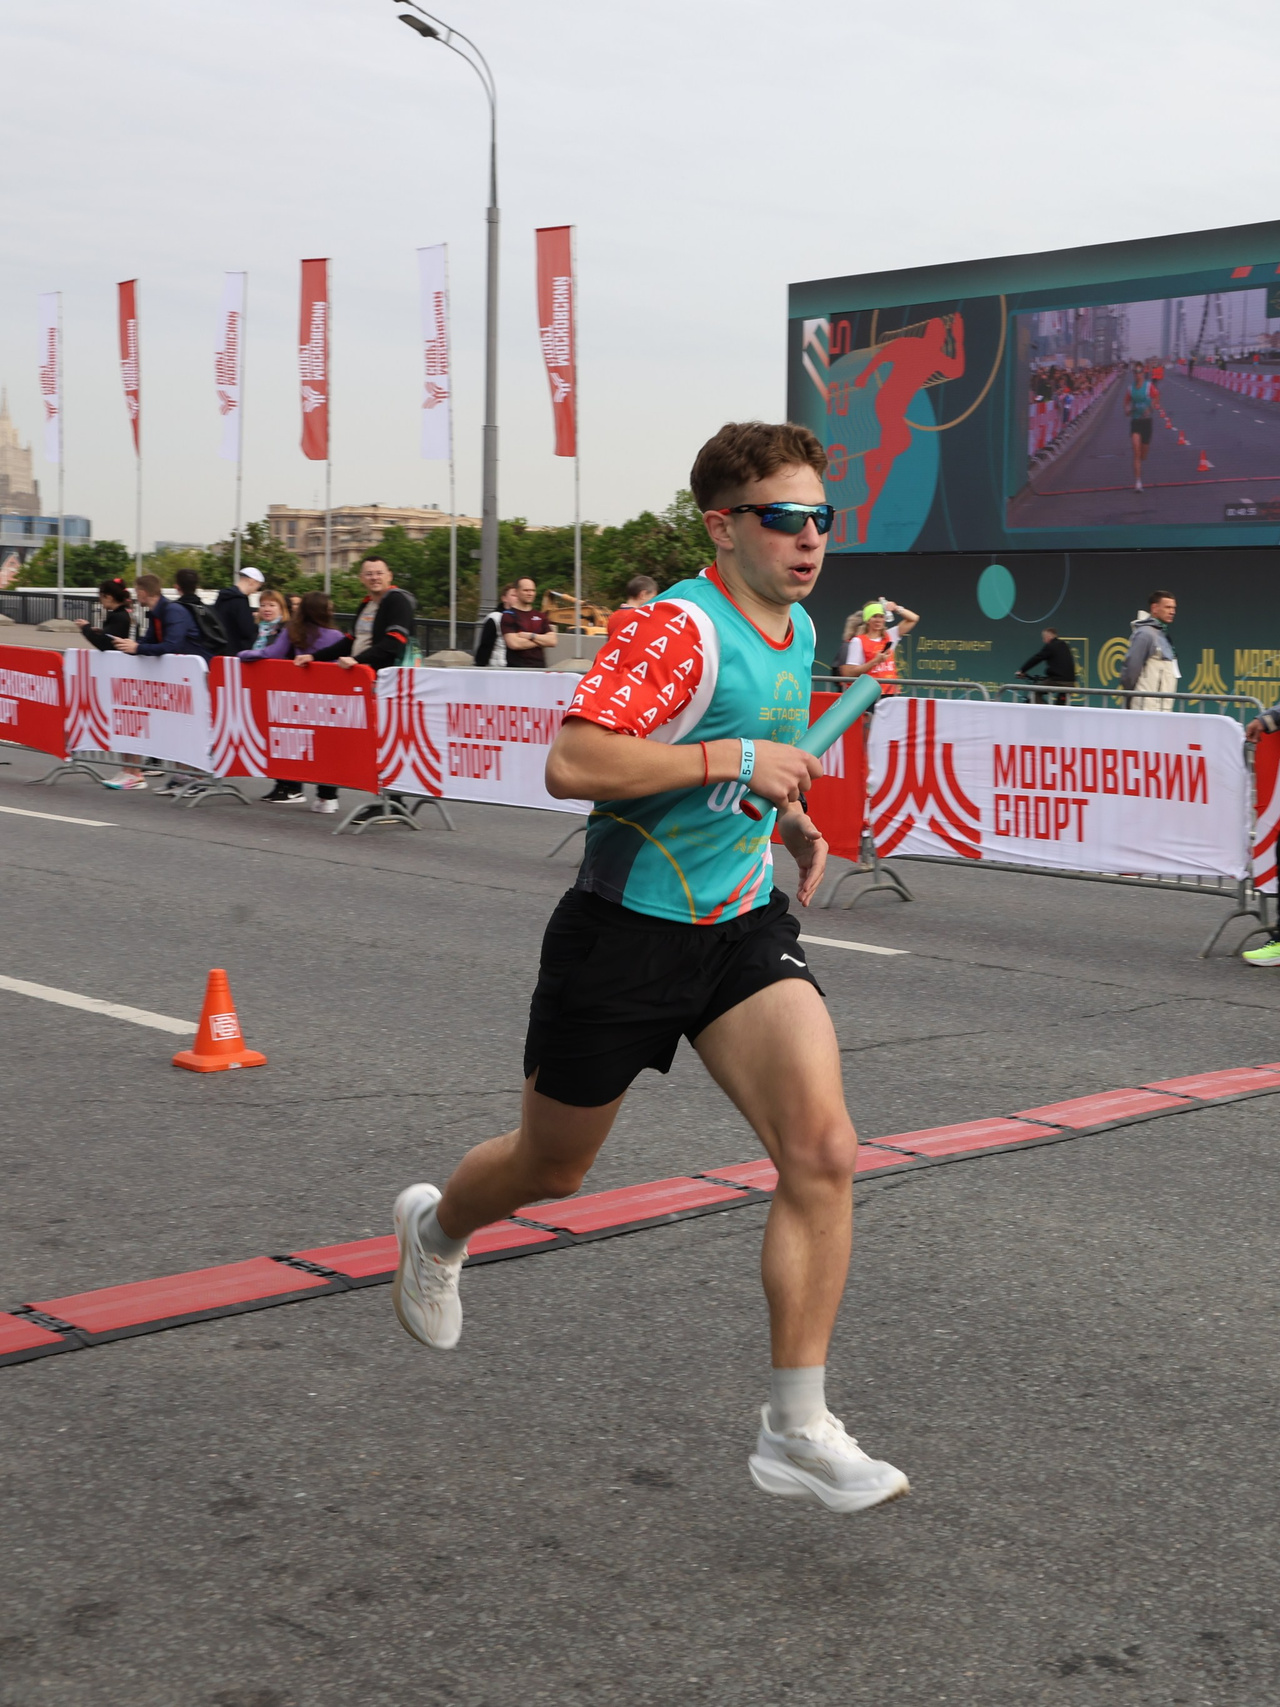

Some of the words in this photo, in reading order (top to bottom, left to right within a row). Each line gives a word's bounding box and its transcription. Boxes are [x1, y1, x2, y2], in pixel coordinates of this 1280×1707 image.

[916, 636, 993, 655] Департамент
[0, 668, 60, 707] СКОВСКИЙ
[110, 677, 195, 716] МОСКОВСКИЙ
[112, 708, 150, 739] СПОРТ
[266, 686, 368, 730] МОСКОВСКИЙ
[268, 726, 315, 761] СПОРТ
[448, 741, 502, 781] СПОРТ
[742, 751, 754, 776] 5-10
[993, 743, 1208, 804] МОСКОВСКИЙ
[994, 793, 1089, 842] СПОРТ
